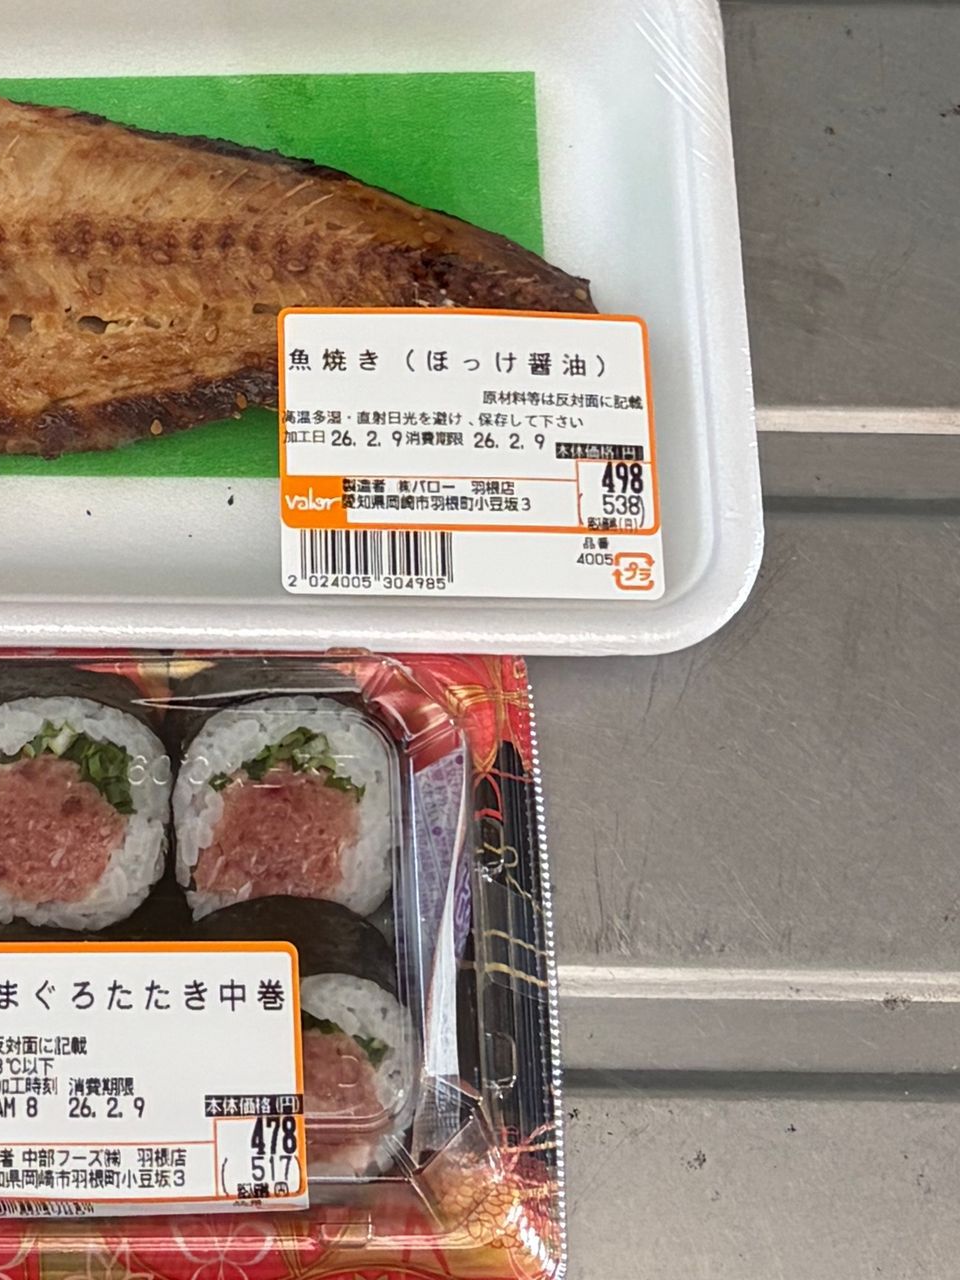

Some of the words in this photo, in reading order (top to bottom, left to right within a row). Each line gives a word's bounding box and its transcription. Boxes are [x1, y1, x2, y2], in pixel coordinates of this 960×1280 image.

[482, 390, 644, 410] 原材料等は反対面に記載
[283, 430, 326, 445] 加工日
[341, 478, 386, 493] 製造者
[470, 480, 516, 496] 羽根店
[601, 461, 645, 495] 498
[285, 486, 341, 511] valor
[582, 536, 609, 550] 品番
[575, 552, 614, 566] 4005
[287, 574, 298, 588] 2
[308, 575, 372, 589] 024005
[382, 576, 447, 591] 304985
[68, 1077, 135, 1097] 消費期限
[250, 1116, 298, 1156] 478
[136, 1147, 187, 1167] 羽根店
